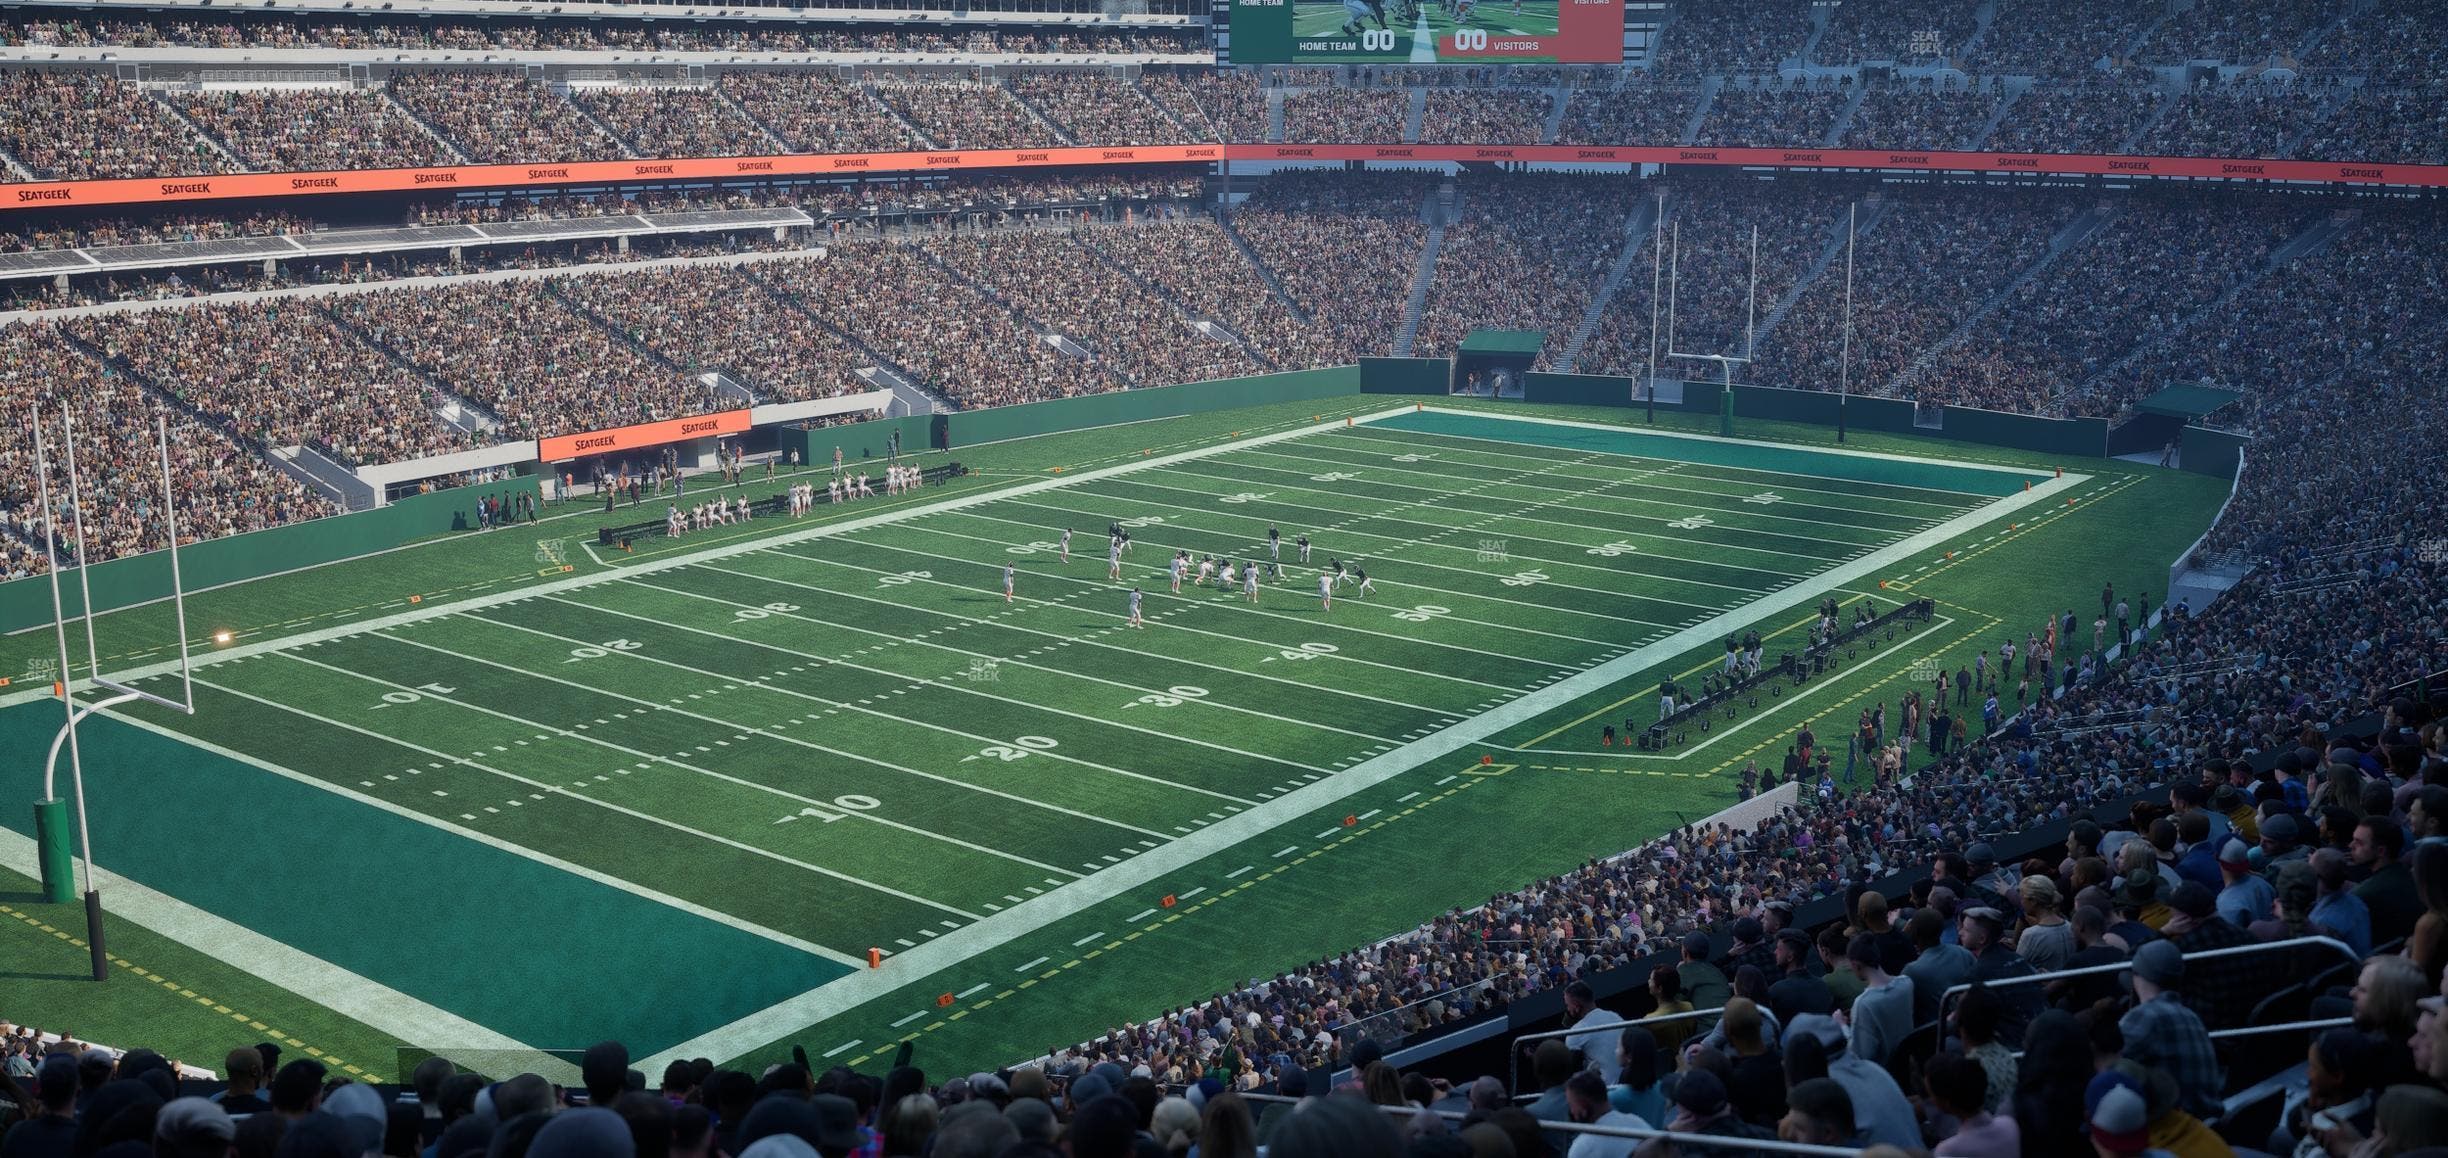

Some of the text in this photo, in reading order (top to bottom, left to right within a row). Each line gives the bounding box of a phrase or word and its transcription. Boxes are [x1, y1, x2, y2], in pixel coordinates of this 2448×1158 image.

[1362, 28, 1395, 51] 00
[1454, 28, 1487, 51] 00
[1299, 41, 1356, 51] HOME TEAM
[1494, 41, 1539, 51] VISITORS
[1017, 154, 1048, 162] SEATGEEK
[1276, 149, 1314, 157] SEATGEEK
[1376, 149, 1413, 157] SEATGEEK
[1476, 150, 1514, 158] SEATGEEK
[1576, 151, 1616, 159] SEATGEEK
[1679, 152, 1719, 161] SEATGEEK
[833, 159, 869, 167] SEATGEEK
[927, 156, 960, 164] SEATGEEK
[1783, 154, 1822, 163] SEATGEEK
[1888, 156, 1929, 165] SEATGEEK
[1996, 158, 2039, 168] SEATGEEK
[635, 165, 673, 175] SEATGEEK
[737, 162, 773, 171] SEATGEEK
[2107, 161, 2152, 171] SEATGEEK
[2221, 164, 2265, 175] SEATGEEK
[415, 173, 456, 184] SEATGEEK
[528, 168, 568, 179] SEATGEEK
[2339, 168, 2384, 180] SEATGEEK
[292, 178, 338, 189] SEATGEEK
[161, 183, 211, 195] SEATGEEK
[18, 188, 71, 202] SEATGEEK
[682, 419, 719, 435] SEATGEEK
[575, 434, 616, 451] SEATGEEK
[1389, 605, 1452, 622] 50
[1281, 643, 1340, 660] 40
[1137, 686, 1210, 708] 30
[979, 736, 1059, 762] 20
[799, 795, 881, 824] 10
